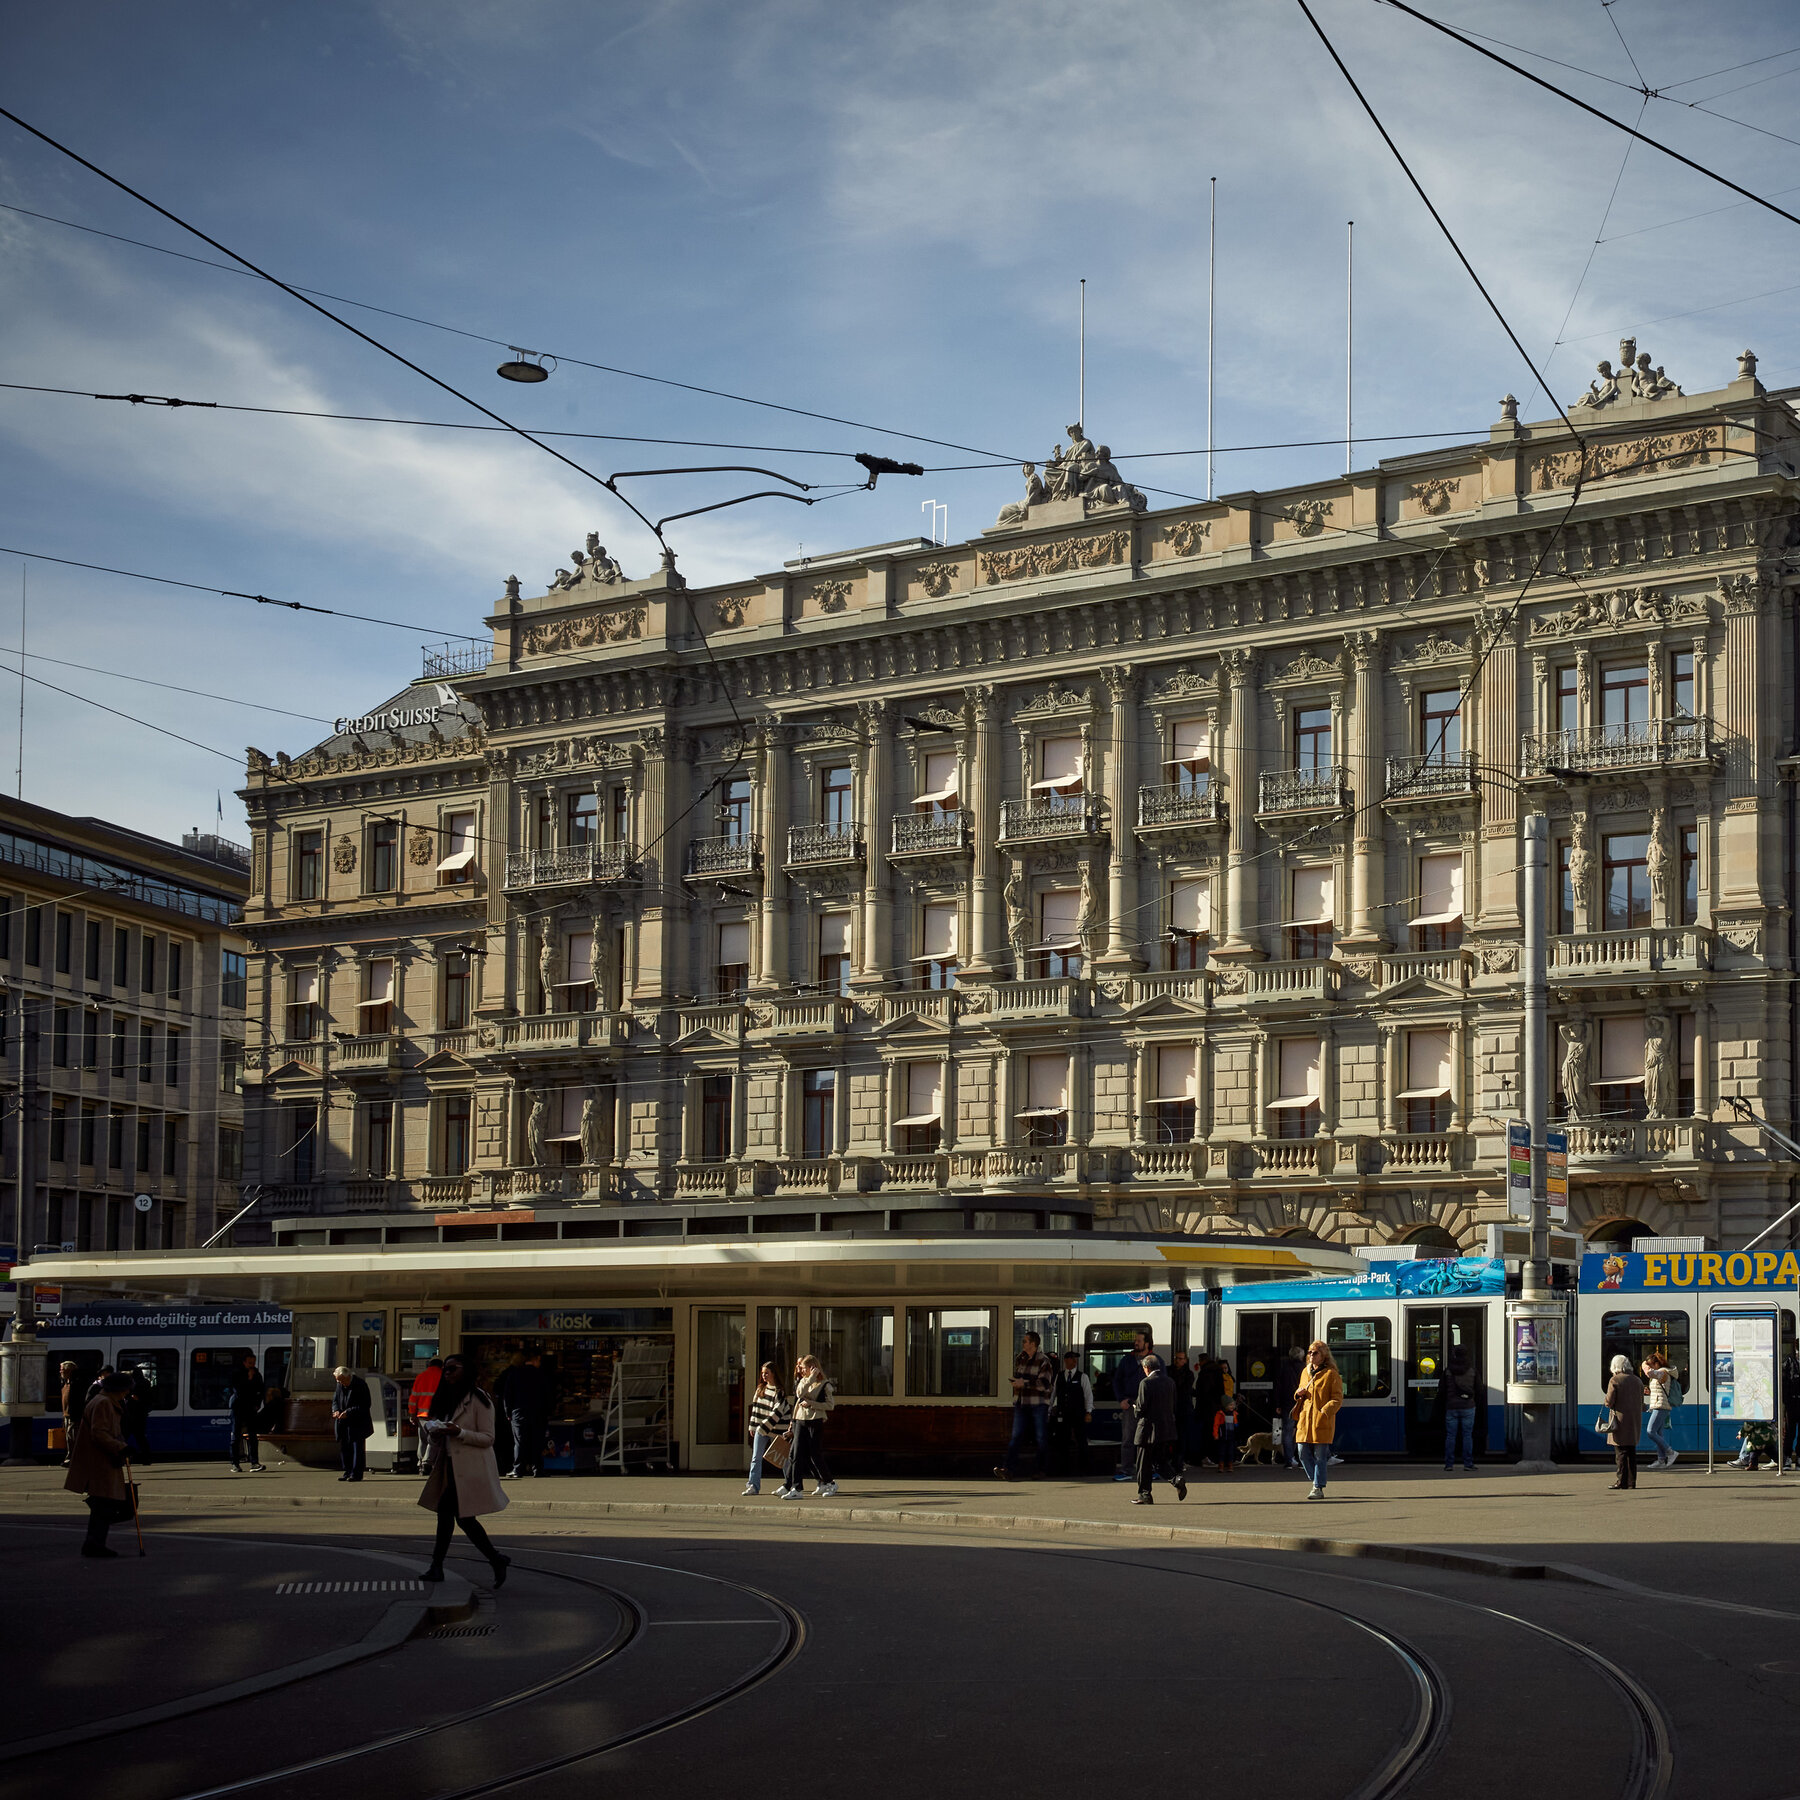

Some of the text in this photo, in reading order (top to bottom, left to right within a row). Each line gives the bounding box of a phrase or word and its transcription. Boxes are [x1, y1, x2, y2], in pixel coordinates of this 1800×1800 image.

[333, 705, 440, 736] CREDIT SUISSE
[1643, 1252, 1800, 1286] EUROPA
[1338, 1272, 1391, 1286] opa-Park
[80, 1313, 102, 1327] das
[105, 1314, 134, 1326] Auto
[137, 1312, 197, 1328] endgültig
[200, 1312, 222, 1325] auf
[223, 1312, 250, 1324] dem
[550, 1312, 592, 1329] kiosk
[1093, 1331, 1100, 1341] 7
